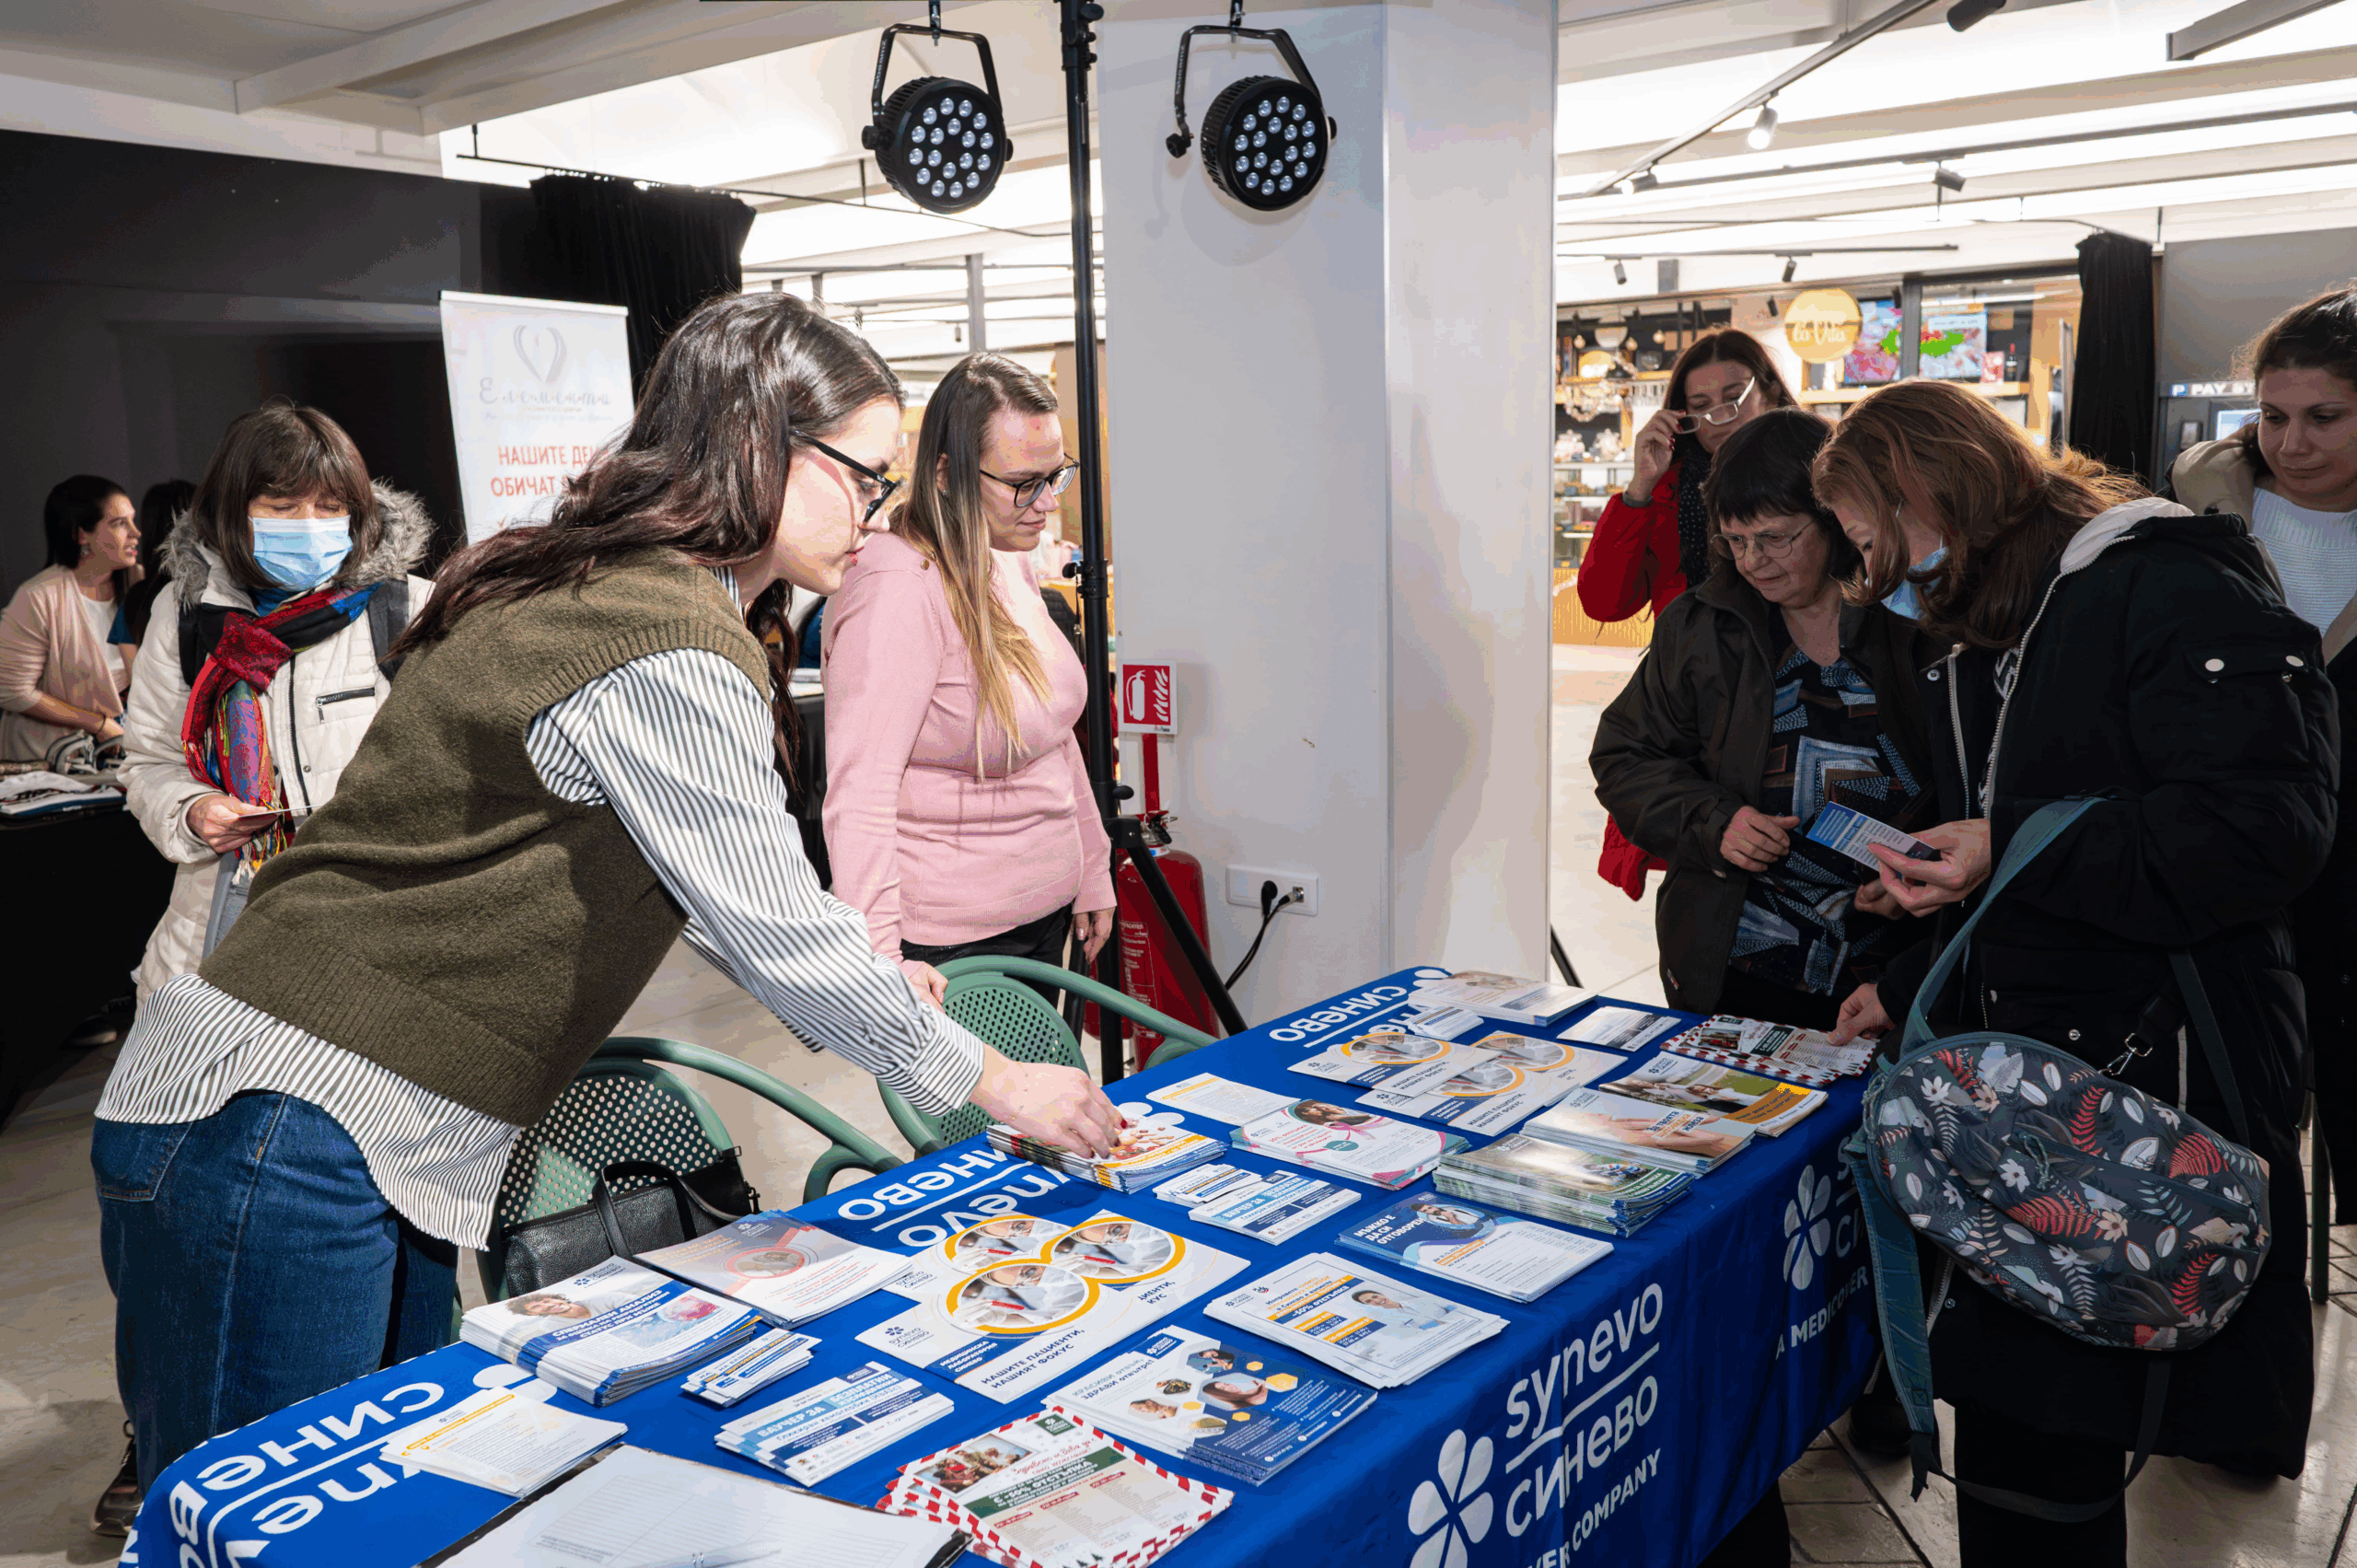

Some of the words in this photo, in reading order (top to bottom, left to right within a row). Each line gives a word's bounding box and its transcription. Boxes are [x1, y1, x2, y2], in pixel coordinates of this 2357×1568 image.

[2191, 383, 2227, 396] PAY
[497, 445, 567, 466] НАШИТЕ
[490, 475, 555, 497] ОБИЧАТ
[1353, 1216, 1387, 1237] МЪЖКО
[1365, 1231, 1380, 1242] ДА
[1380, 1225, 1393, 1235] СИ
[1376, 1217, 1426, 1245] ОТГОВОРЕН
[552, 1307, 618, 1338] СПЕРМАЛЕН
[619, 1289, 664, 1312] АНАЛИЗ
[580, 1323, 613, 1338] СТАТУС
[981, 1360, 1026, 1385] НАШИТЕ
[1027, 1329, 1085, 1360] ПАЦИЕНТИ,
[991, 1365, 1038, 1388] НАШИЯТ
[1038, 1343, 1074, 1365] ФОКУС
[1505, 1283, 1663, 1440] synevo
[830, 1373, 894, 1402] БЕЗПЛАТНИ
[1081, 1380, 1119, 1400] ЗДРАВИ
[757, 1411, 805, 1437] ВАУЧЕР
[805, 1406, 827, 1416] ЗА
[1031, 1460, 1094, 1487] ОТСТЪПКА
[1572, 1447, 1661, 1551] COMPANY
